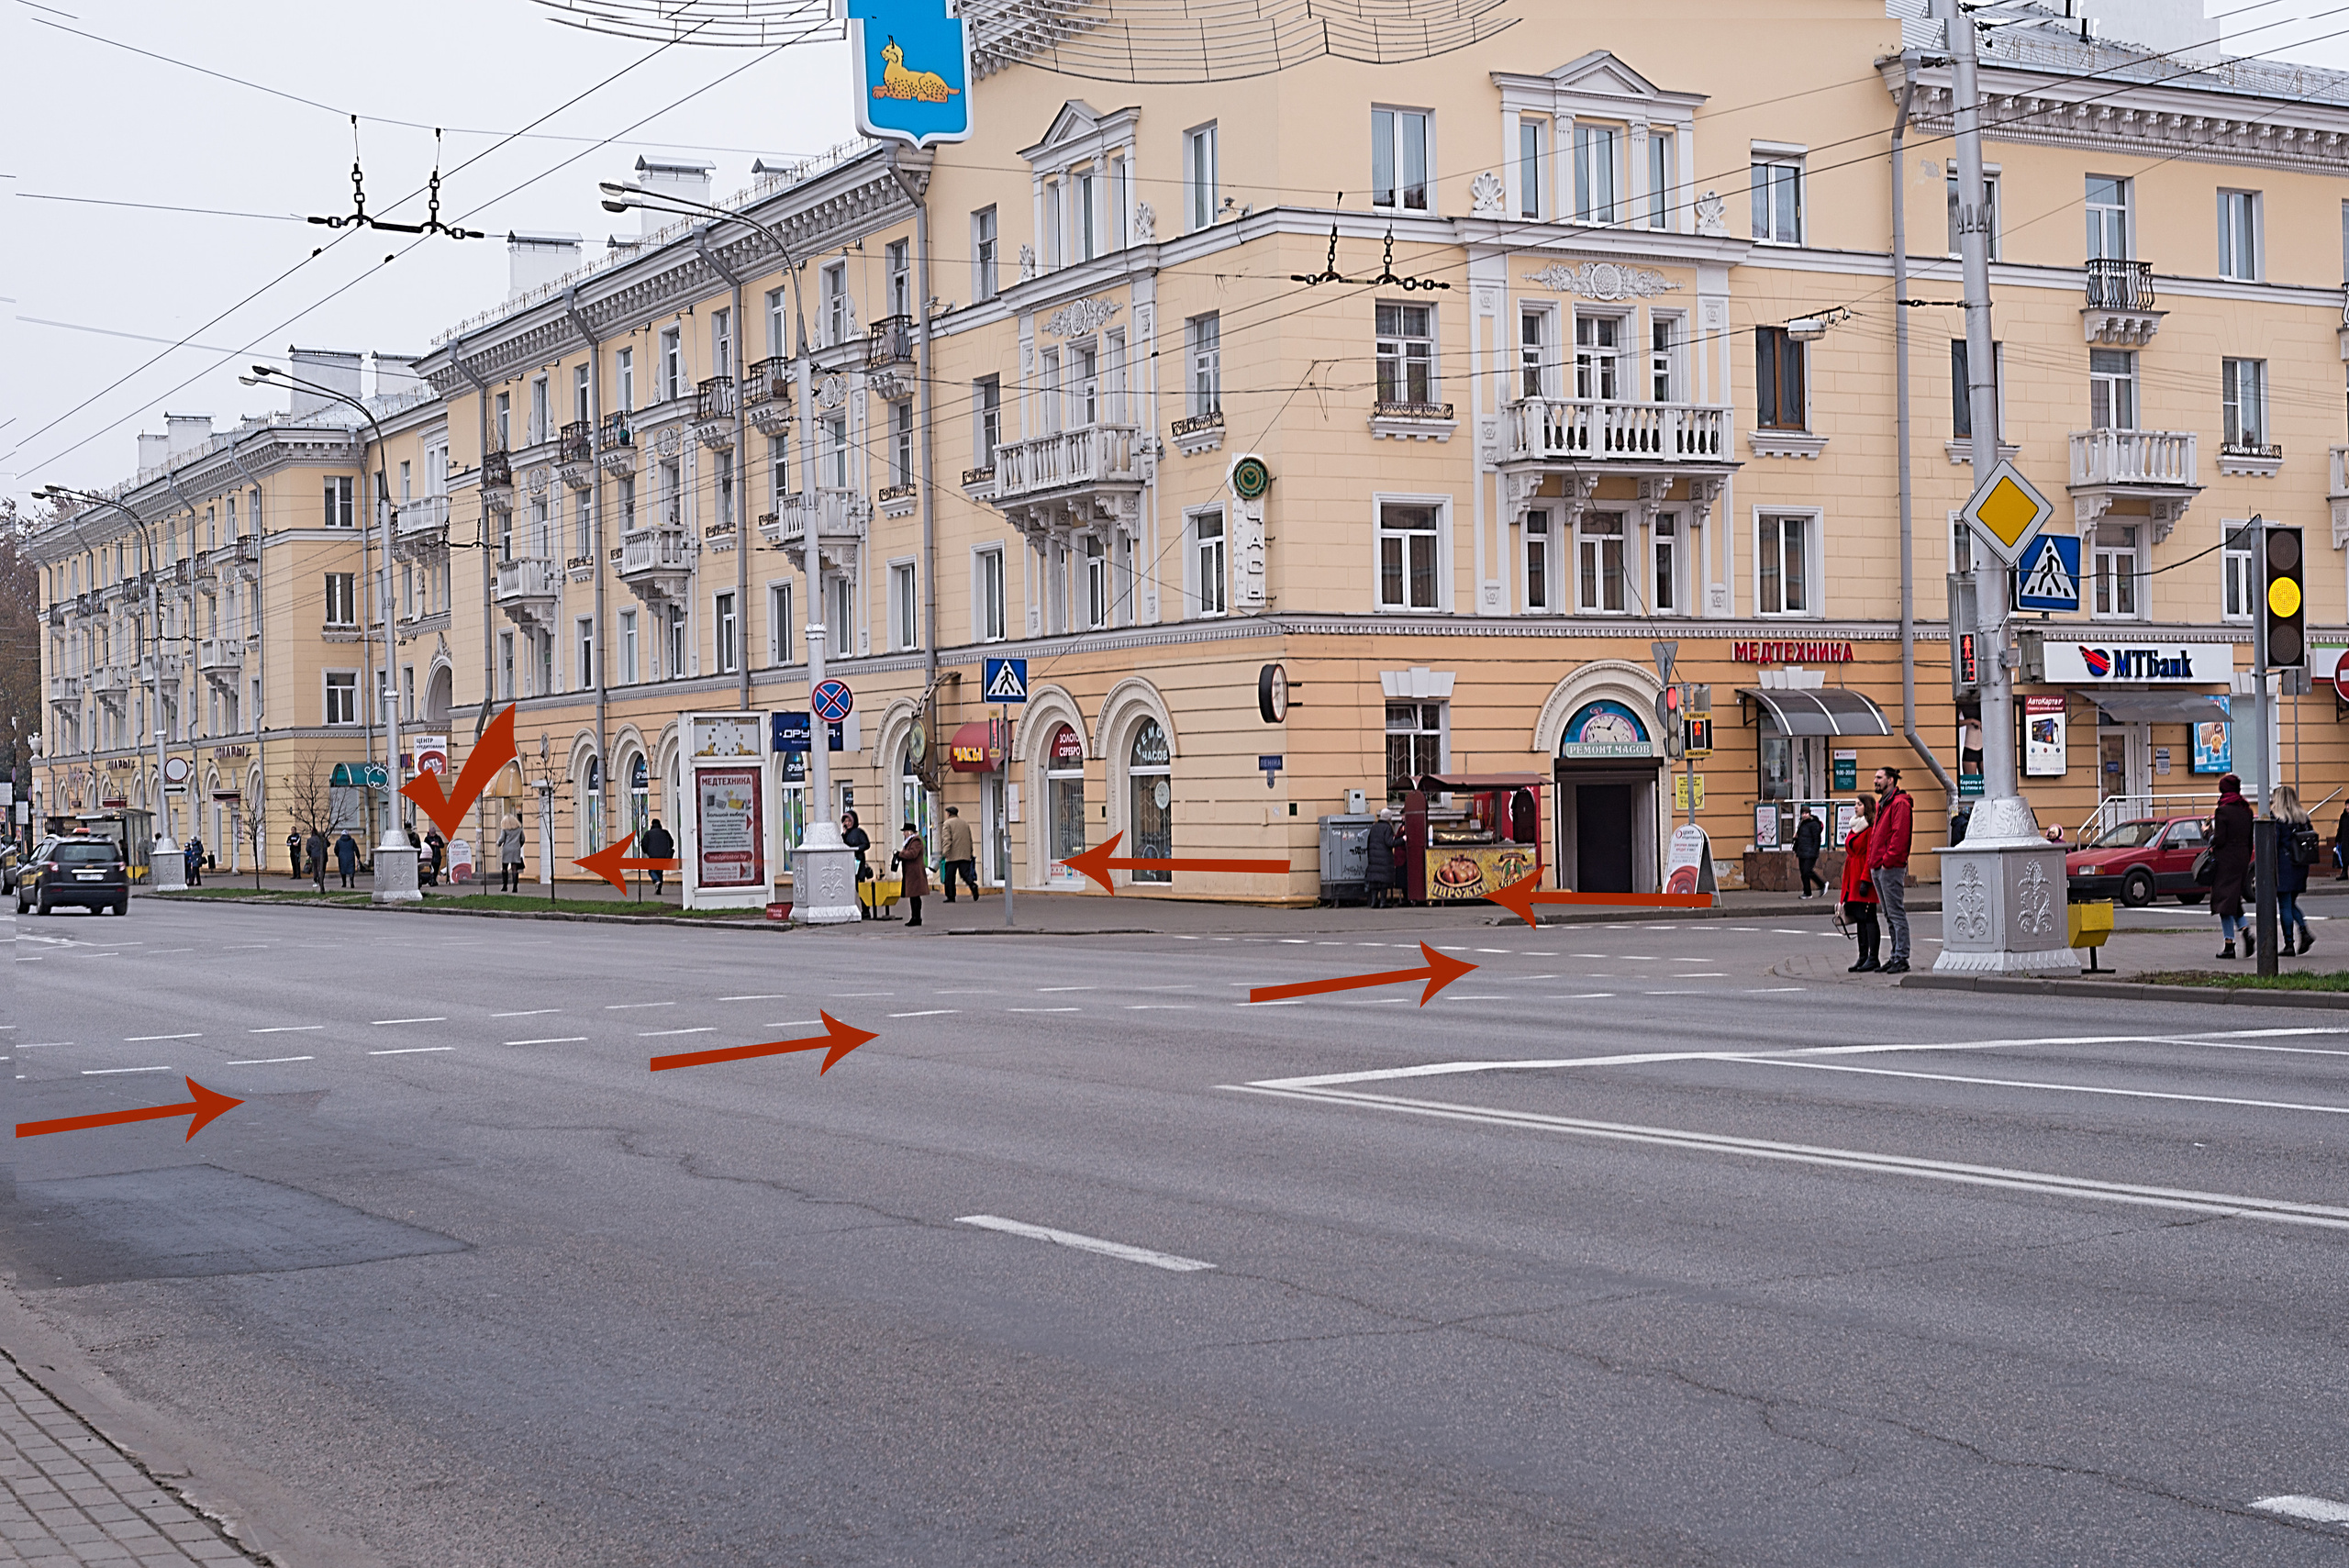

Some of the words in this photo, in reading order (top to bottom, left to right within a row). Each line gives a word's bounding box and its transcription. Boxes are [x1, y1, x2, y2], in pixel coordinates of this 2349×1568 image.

[1731, 641, 1854, 664] МЕДТЕХНИКА
[2112, 650, 2193, 678] МТБанк
[2027, 697, 2058, 706] АвтоКарта
[1059, 733, 1080, 743] ЗОЛОТО
[953, 747, 983, 762] ЧАСЫ
[1059, 746, 1081, 756] СЕРЕБРО
[1569, 745, 1612, 755] РЕМОНТ
[1615, 744, 1650, 754] ЧАСОВ
[1142, 751, 1168, 761] ЧАСОВ
[424, 758, 442, 770] ATL
[1260, 759, 1281, 767] ЛЕНІНА
[702, 777, 751, 786] МЕДТЕХНИКА
[1430, 881, 1490, 898] ПИРОЖКИ
